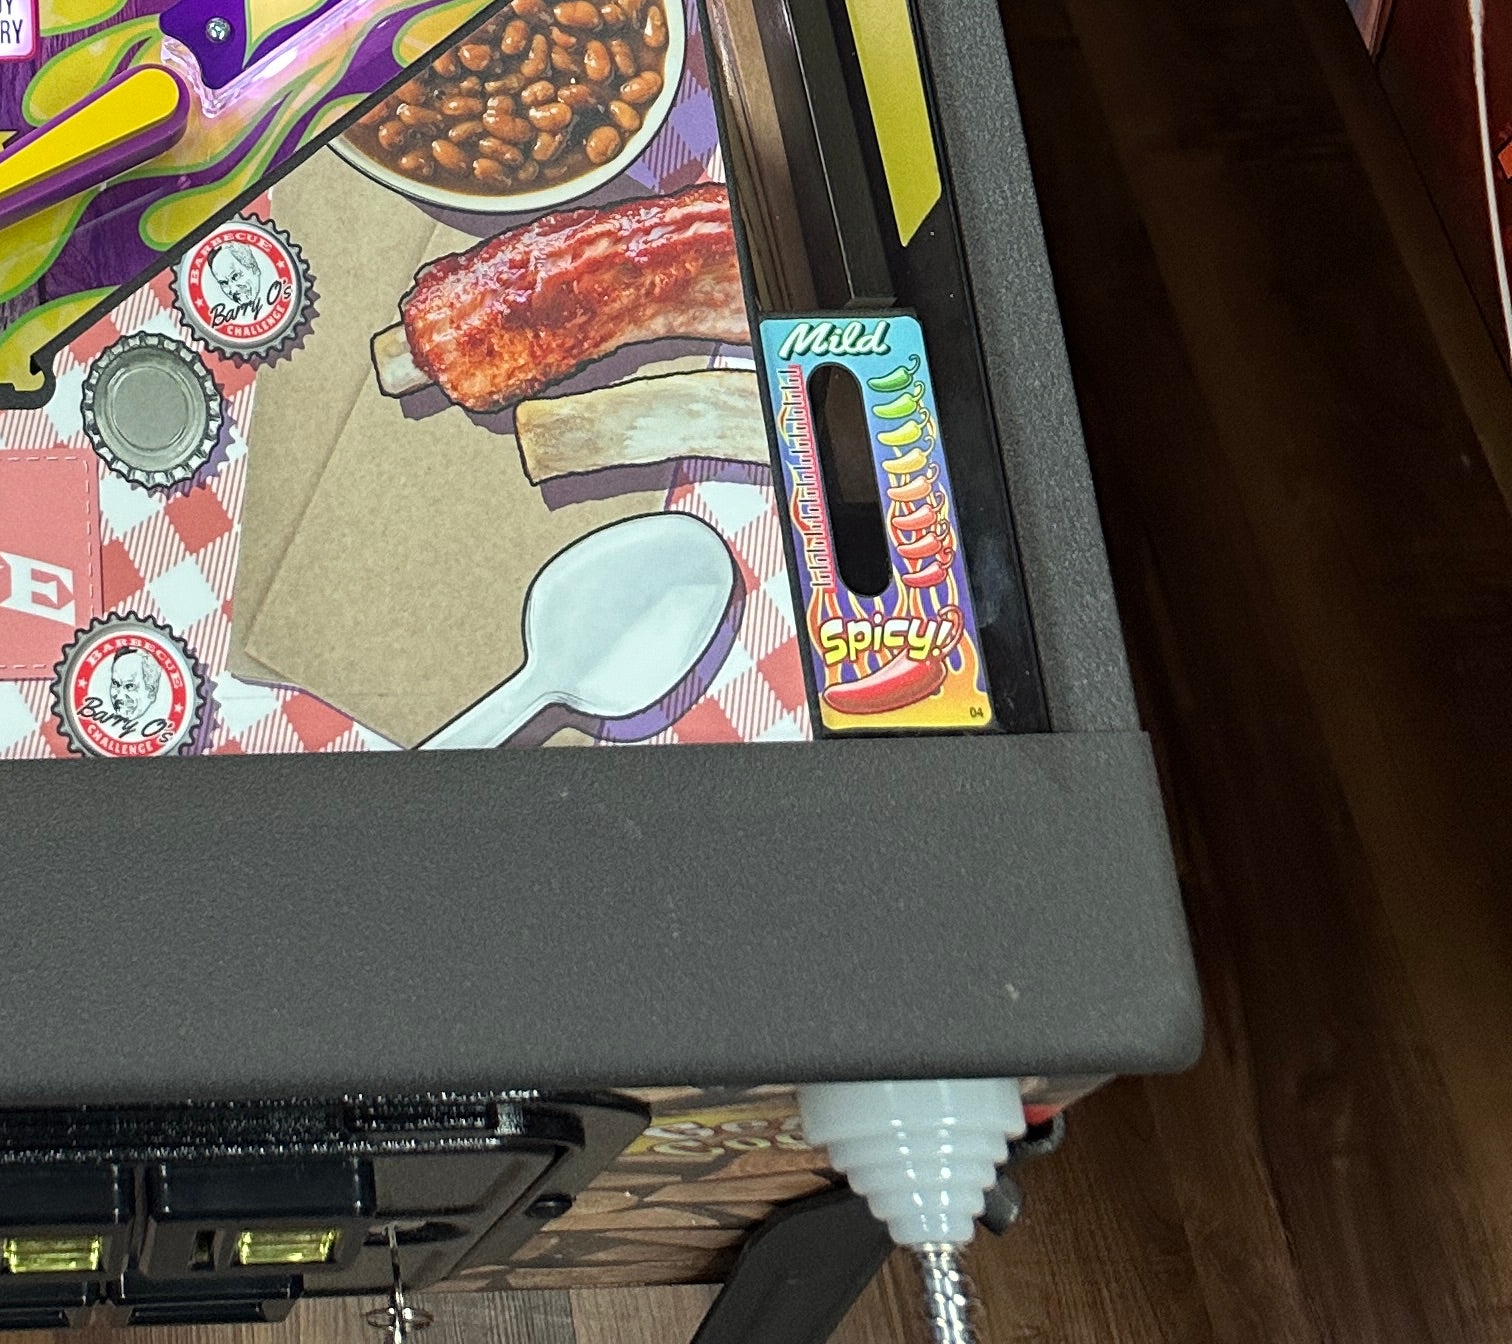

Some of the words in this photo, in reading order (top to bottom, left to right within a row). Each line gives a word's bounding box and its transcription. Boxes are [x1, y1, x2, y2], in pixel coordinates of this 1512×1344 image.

[189, 230, 273, 286] BARBECUE
[209, 298, 264, 329] Barry
[265, 278, 293, 306] O's
[225, 303, 287, 337] CHALLENGE
[778, 321, 892, 359] Mild
[822, 614, 952, 664] Spicy!
